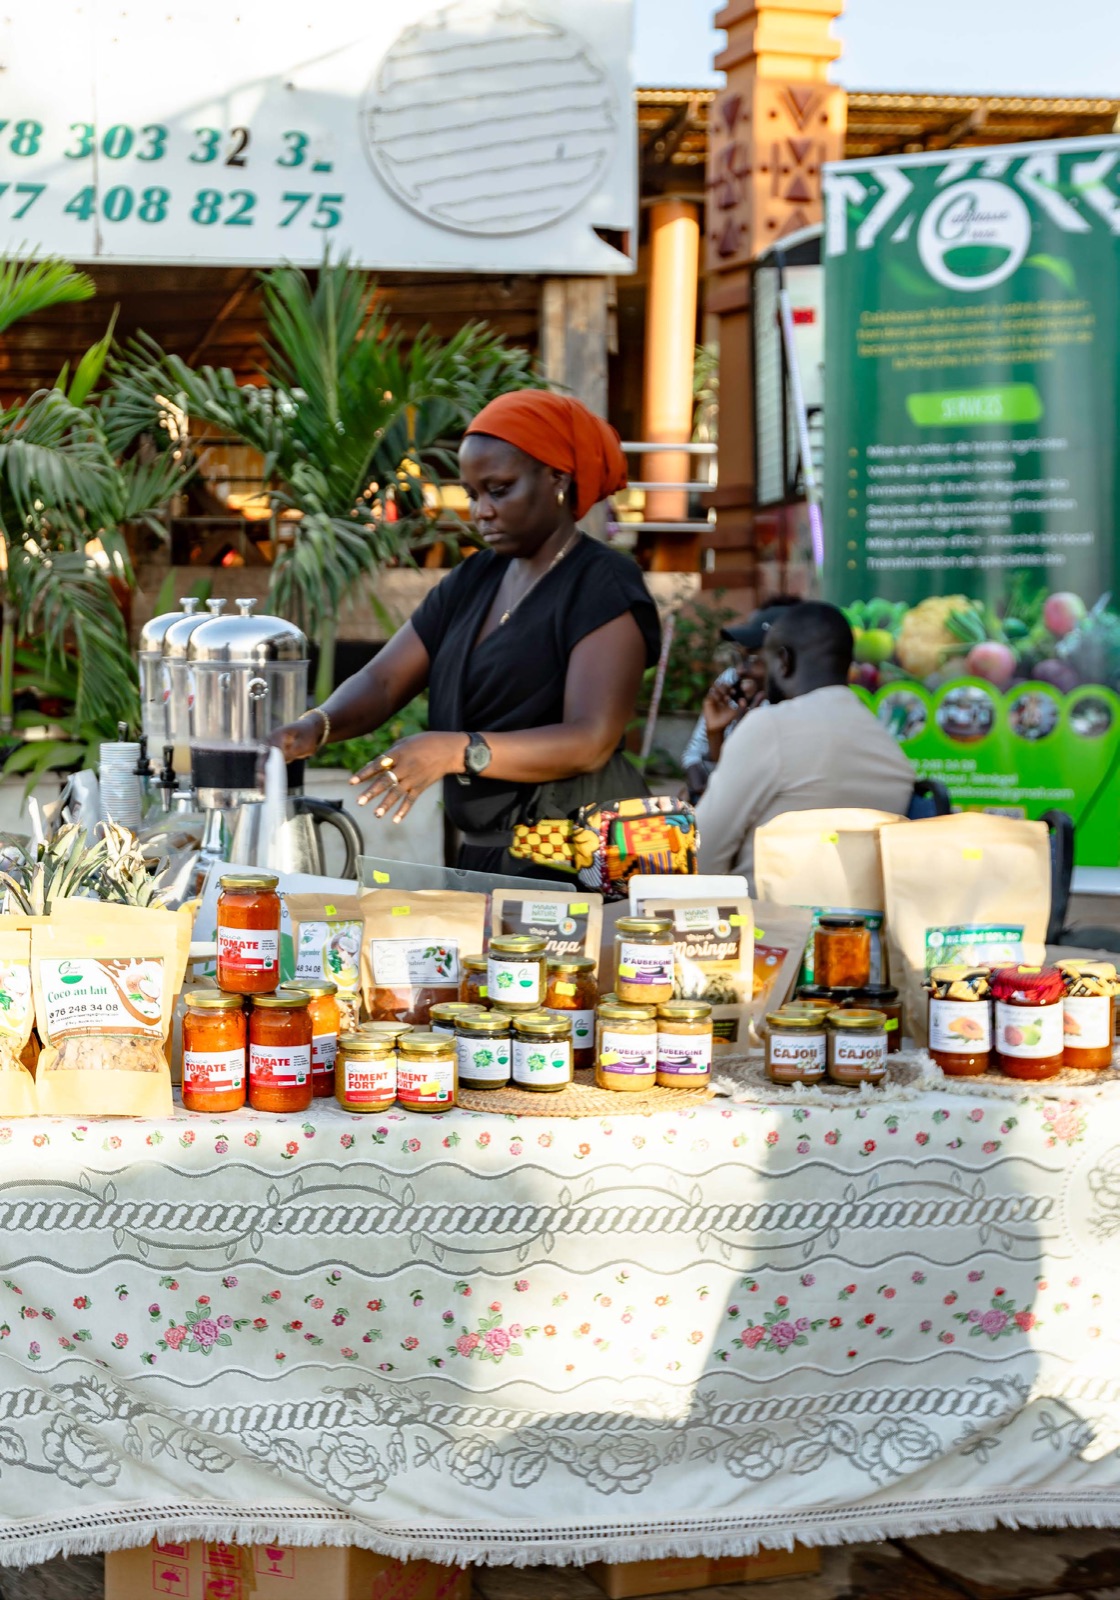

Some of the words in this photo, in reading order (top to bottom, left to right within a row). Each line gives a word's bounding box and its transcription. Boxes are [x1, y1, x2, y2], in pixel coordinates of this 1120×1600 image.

[64, 122, 169, 162] 303
[190, 127, 250, 167] 32
[64, 185, 172, 223] 408
[190, 188, 257, 226] 82
[278, 191, 345, 230] 75
[940, 394, 1004, 420] SERVICES
[219, 937, 259, 950] TOMATE
[673, 940, 738, 960] Moringa
[47, 988, 71, 1003] Coco
[73, 987, 87, 996] au
[90, 985, 108, 995] lait
[55, 1008, 66, 1018] 76
[68, 1004, 87, 1014] 248
[90, 1004, 103, 1012] 34
[105, 1004, 119, 1012] 08
[773, 1048, 817, 1059] CAJOU
[838, 1048, 883, 1059] CAJOU
[186, 1062, 226, 1073] TOMATE
[251, 1055, 290, 1067] TOMATE
[348, 1072, 388, 1081] PIMENT
[348, 1081, 376, 1089] FORT
